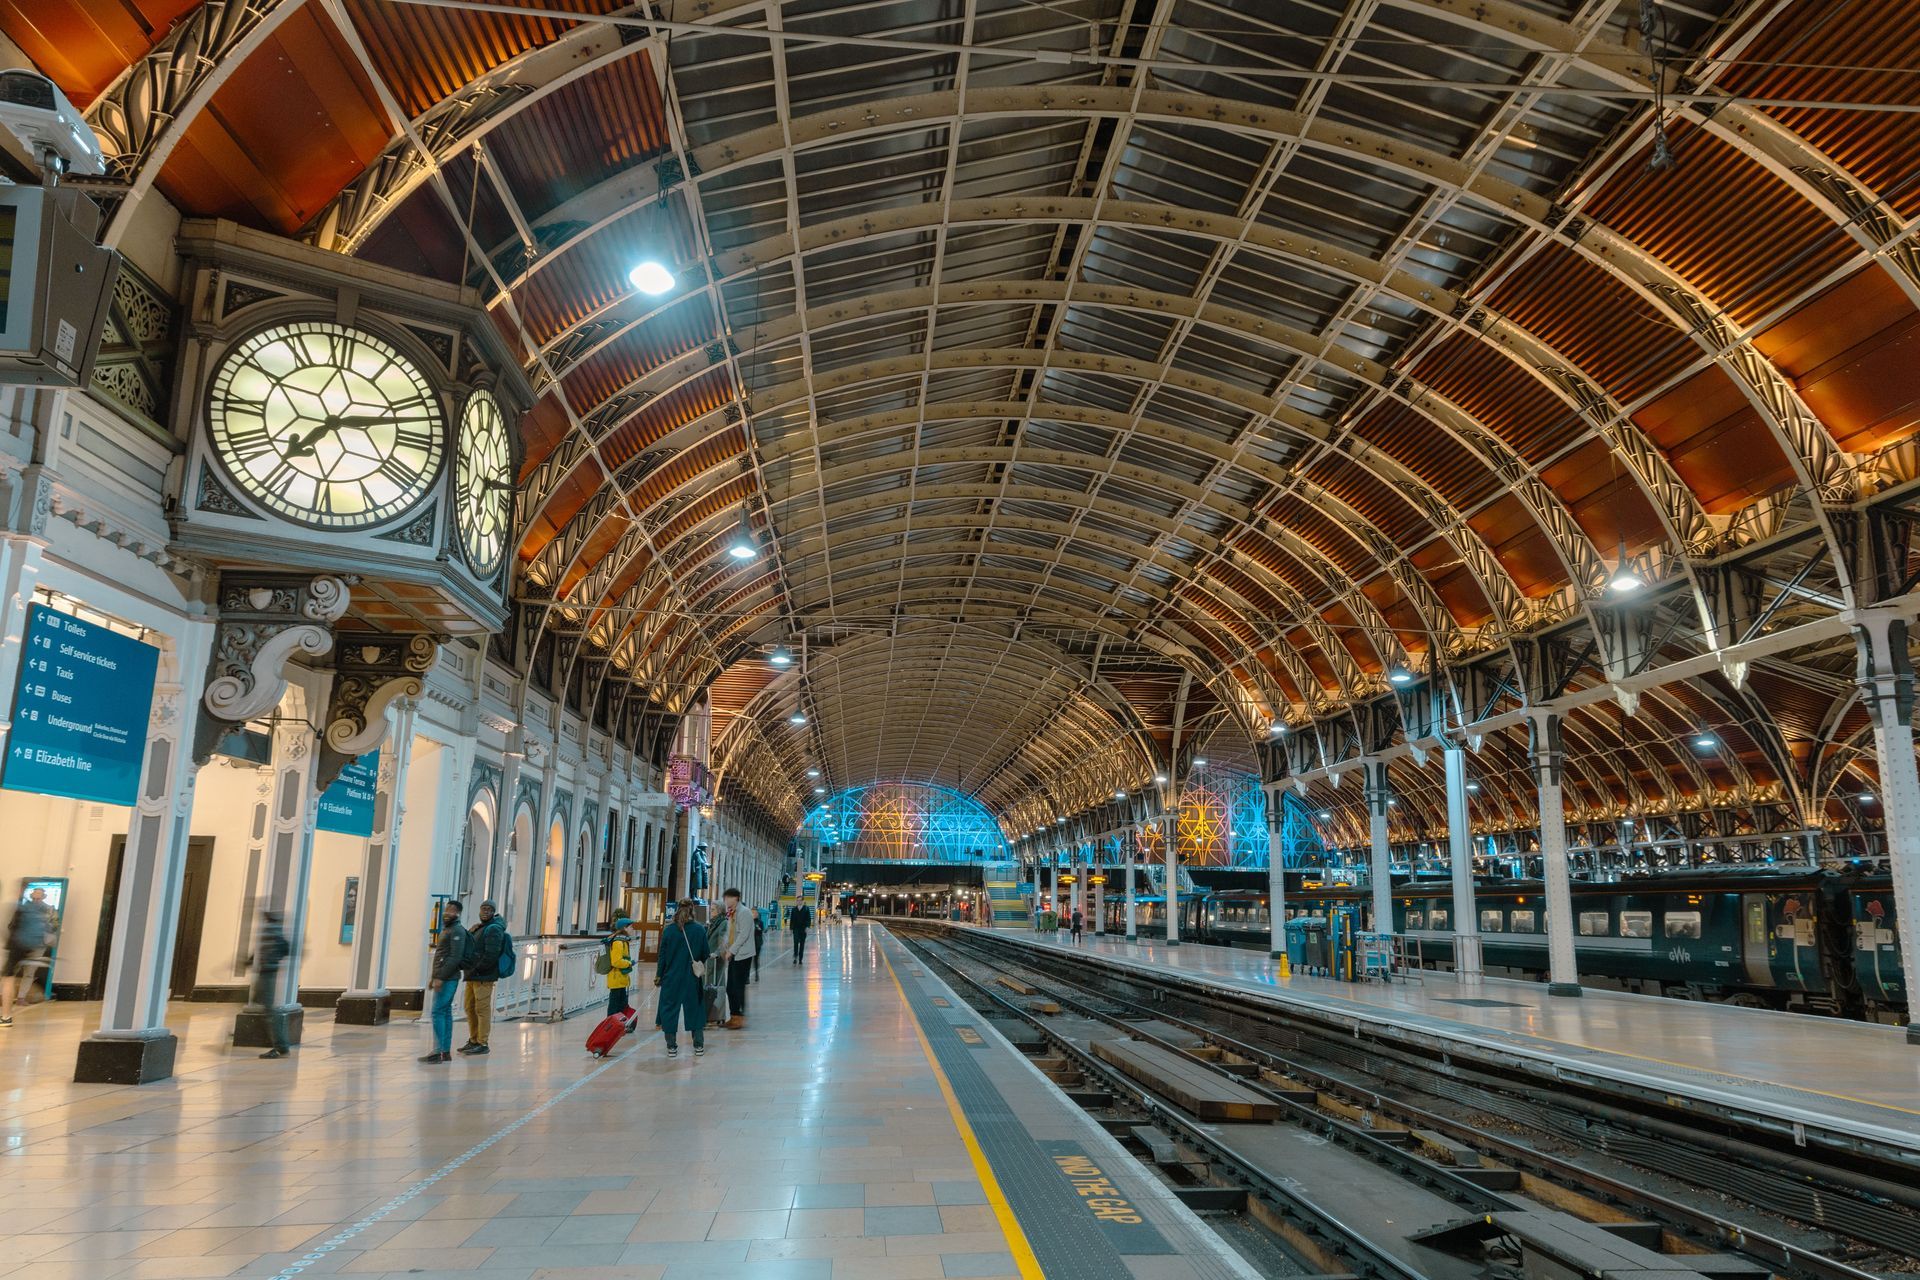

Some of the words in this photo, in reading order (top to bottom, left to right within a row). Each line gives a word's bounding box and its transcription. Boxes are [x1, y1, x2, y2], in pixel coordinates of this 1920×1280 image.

[64, 621, 86, 637] Toilets
[60, 643, 74, 656] Self
[73, 651, 96, 664] service
[96, 655, 117, 670] tickets
[56, 666, 74, 680] Taxis
[51, 689, 72, 704] Buses
[47, 714, 93, 734] Underground
[35, 749, 76, 769] Elizabeth
[76, 757, 92, 771] line
[346, 788, 361, 799] Platform
[328, 803, 345, 815] Elizabeth
[345, 806, 353, 816] line
[1668, 945, 1691, 964] GWR
[1052, 1155, 1102, 1176] MIND
[1071, 1177, 1120, 1196] THE
[1086, 1198, 1143, 1224] GAP
